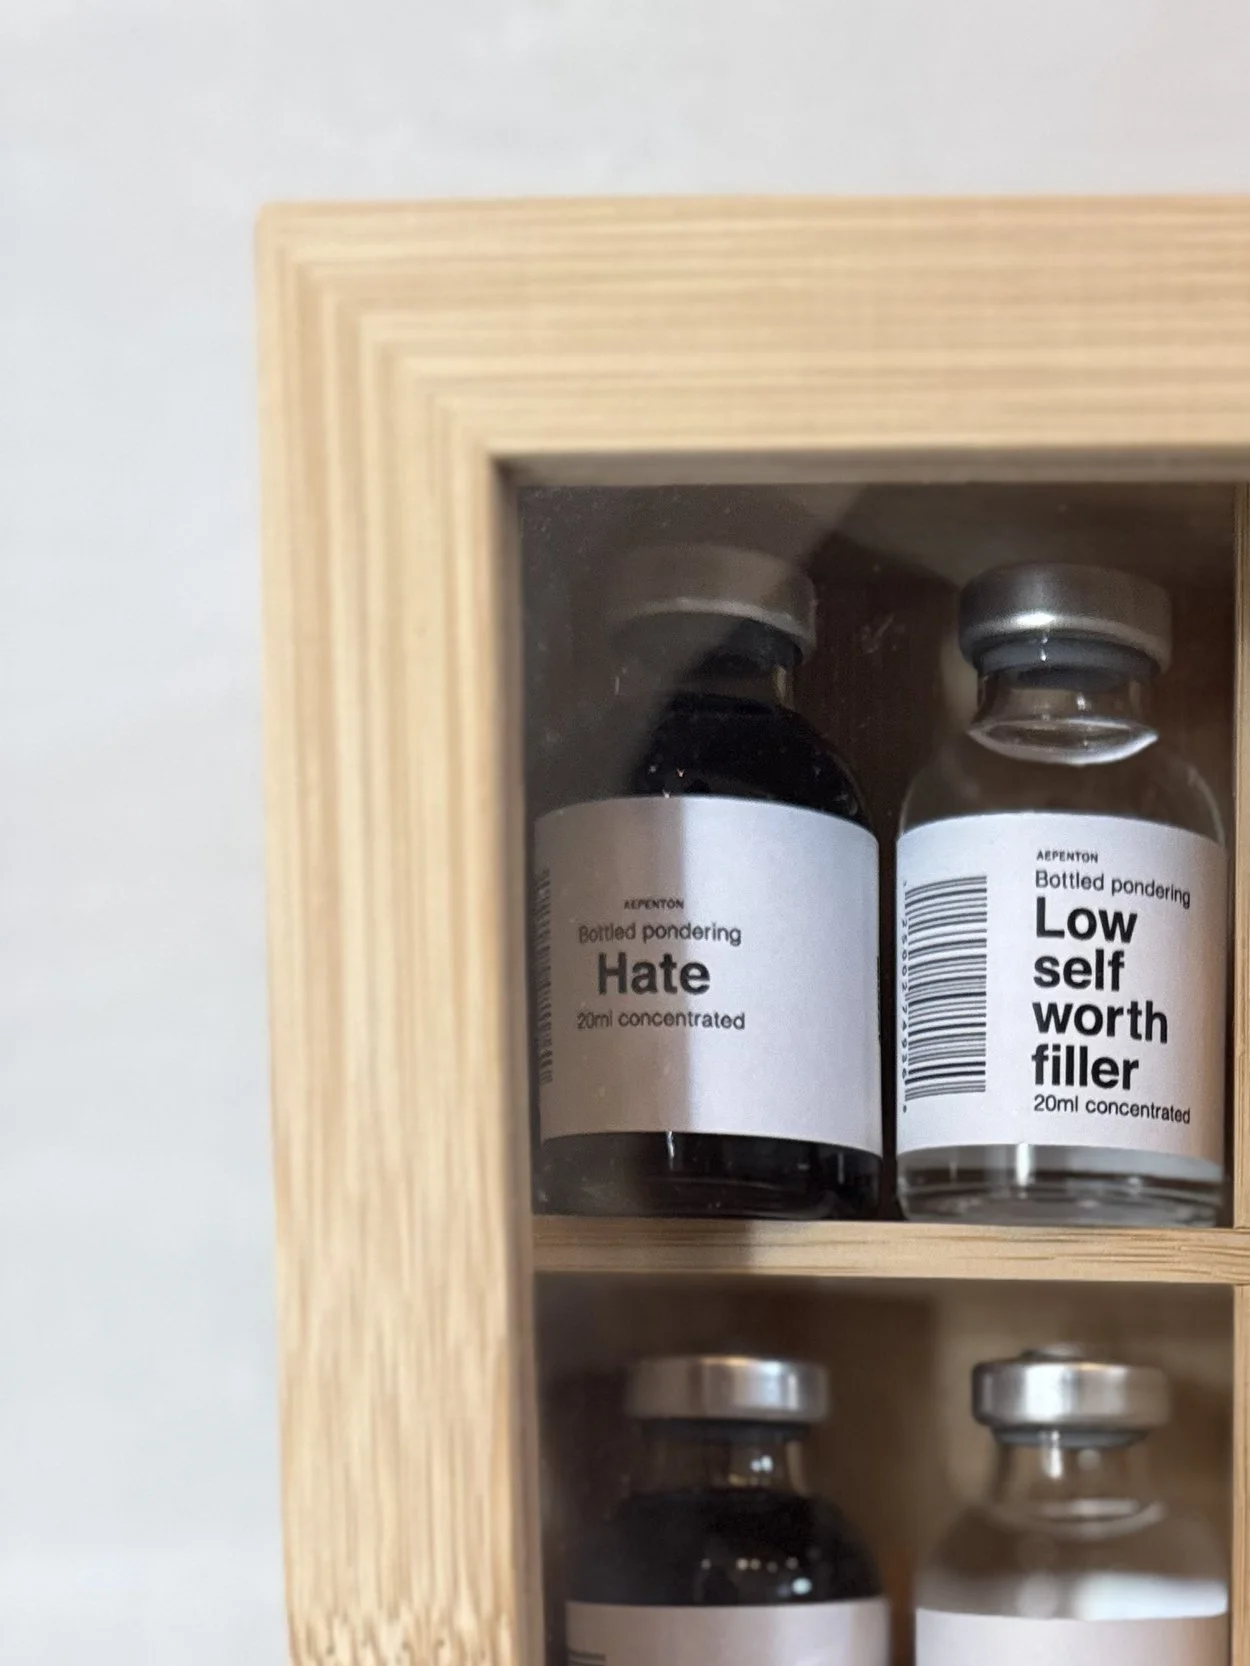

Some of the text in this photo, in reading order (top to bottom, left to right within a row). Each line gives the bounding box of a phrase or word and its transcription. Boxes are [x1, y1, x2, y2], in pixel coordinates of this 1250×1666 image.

[1036, 850, 1099, 863] AEPENTON
[1035, 870, 1191, 909] Bottled pondering
[579, 922, 742, 947] Bottled pondering
[1035, 896, 1138, 943] Low
[597, 951, 711, 994] Hate
[1033, 949, 1125, 991] self
[577, 1010, 746, 1030] 20ml concentrated
[1032, 1000, 1168, 1044] worth
[1031, 1043, 1139, 1090] filler
[1034, 1094, 1191, 1124] 20ml concentrated
